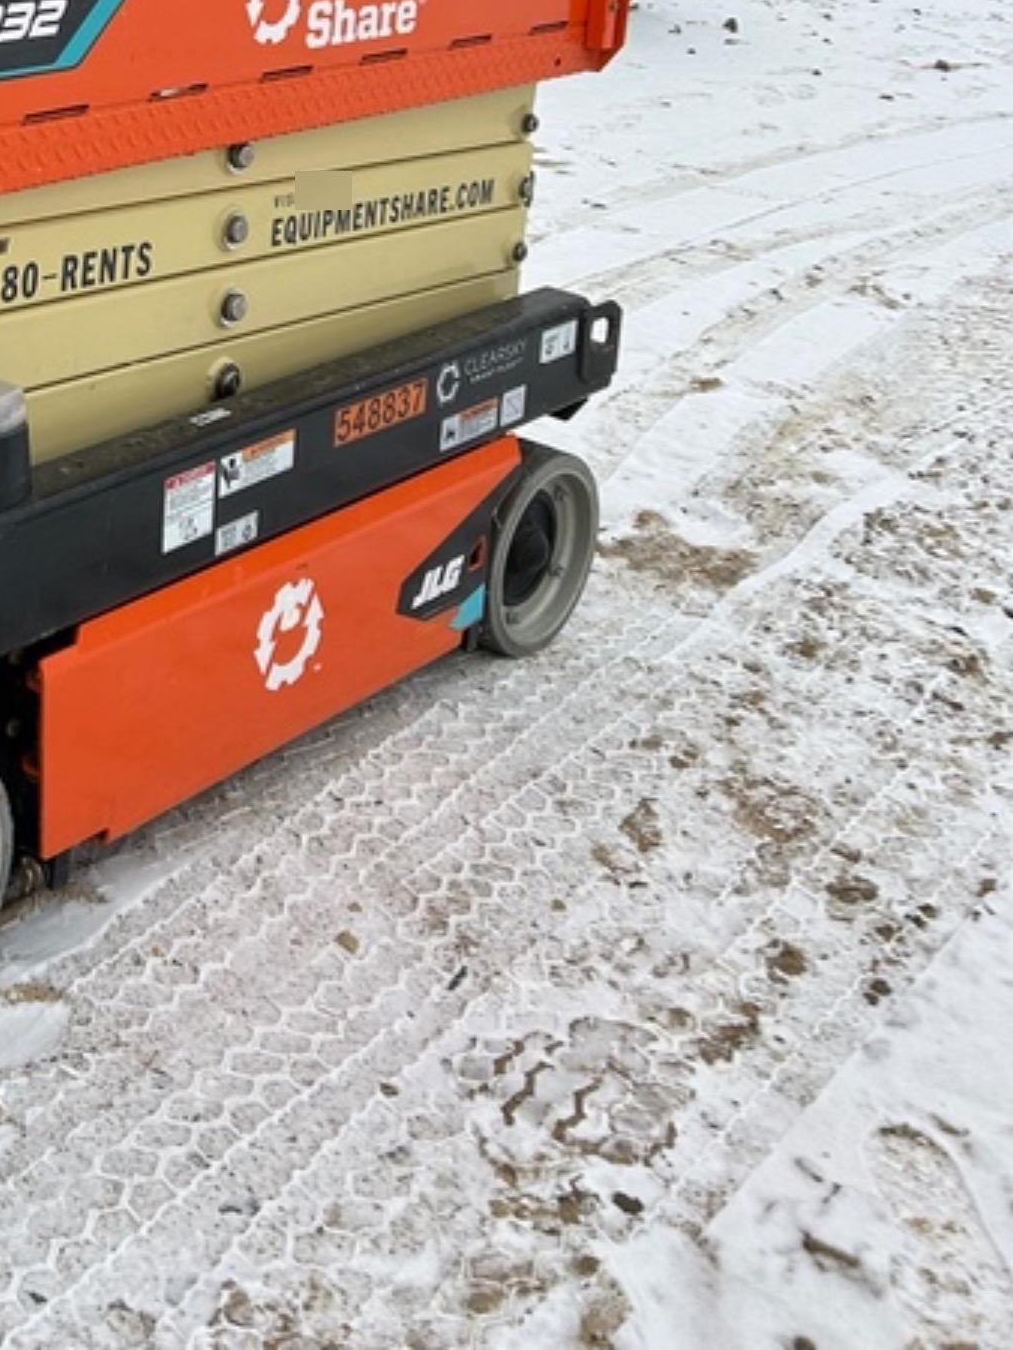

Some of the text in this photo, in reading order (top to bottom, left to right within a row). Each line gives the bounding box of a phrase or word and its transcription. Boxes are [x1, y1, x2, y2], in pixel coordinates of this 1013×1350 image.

[271, 179, 495, 247] EQUIPMENTSHARE.COM
[336, 382, 424, 443] 548837
[411, 553, 465, 610] JLG
